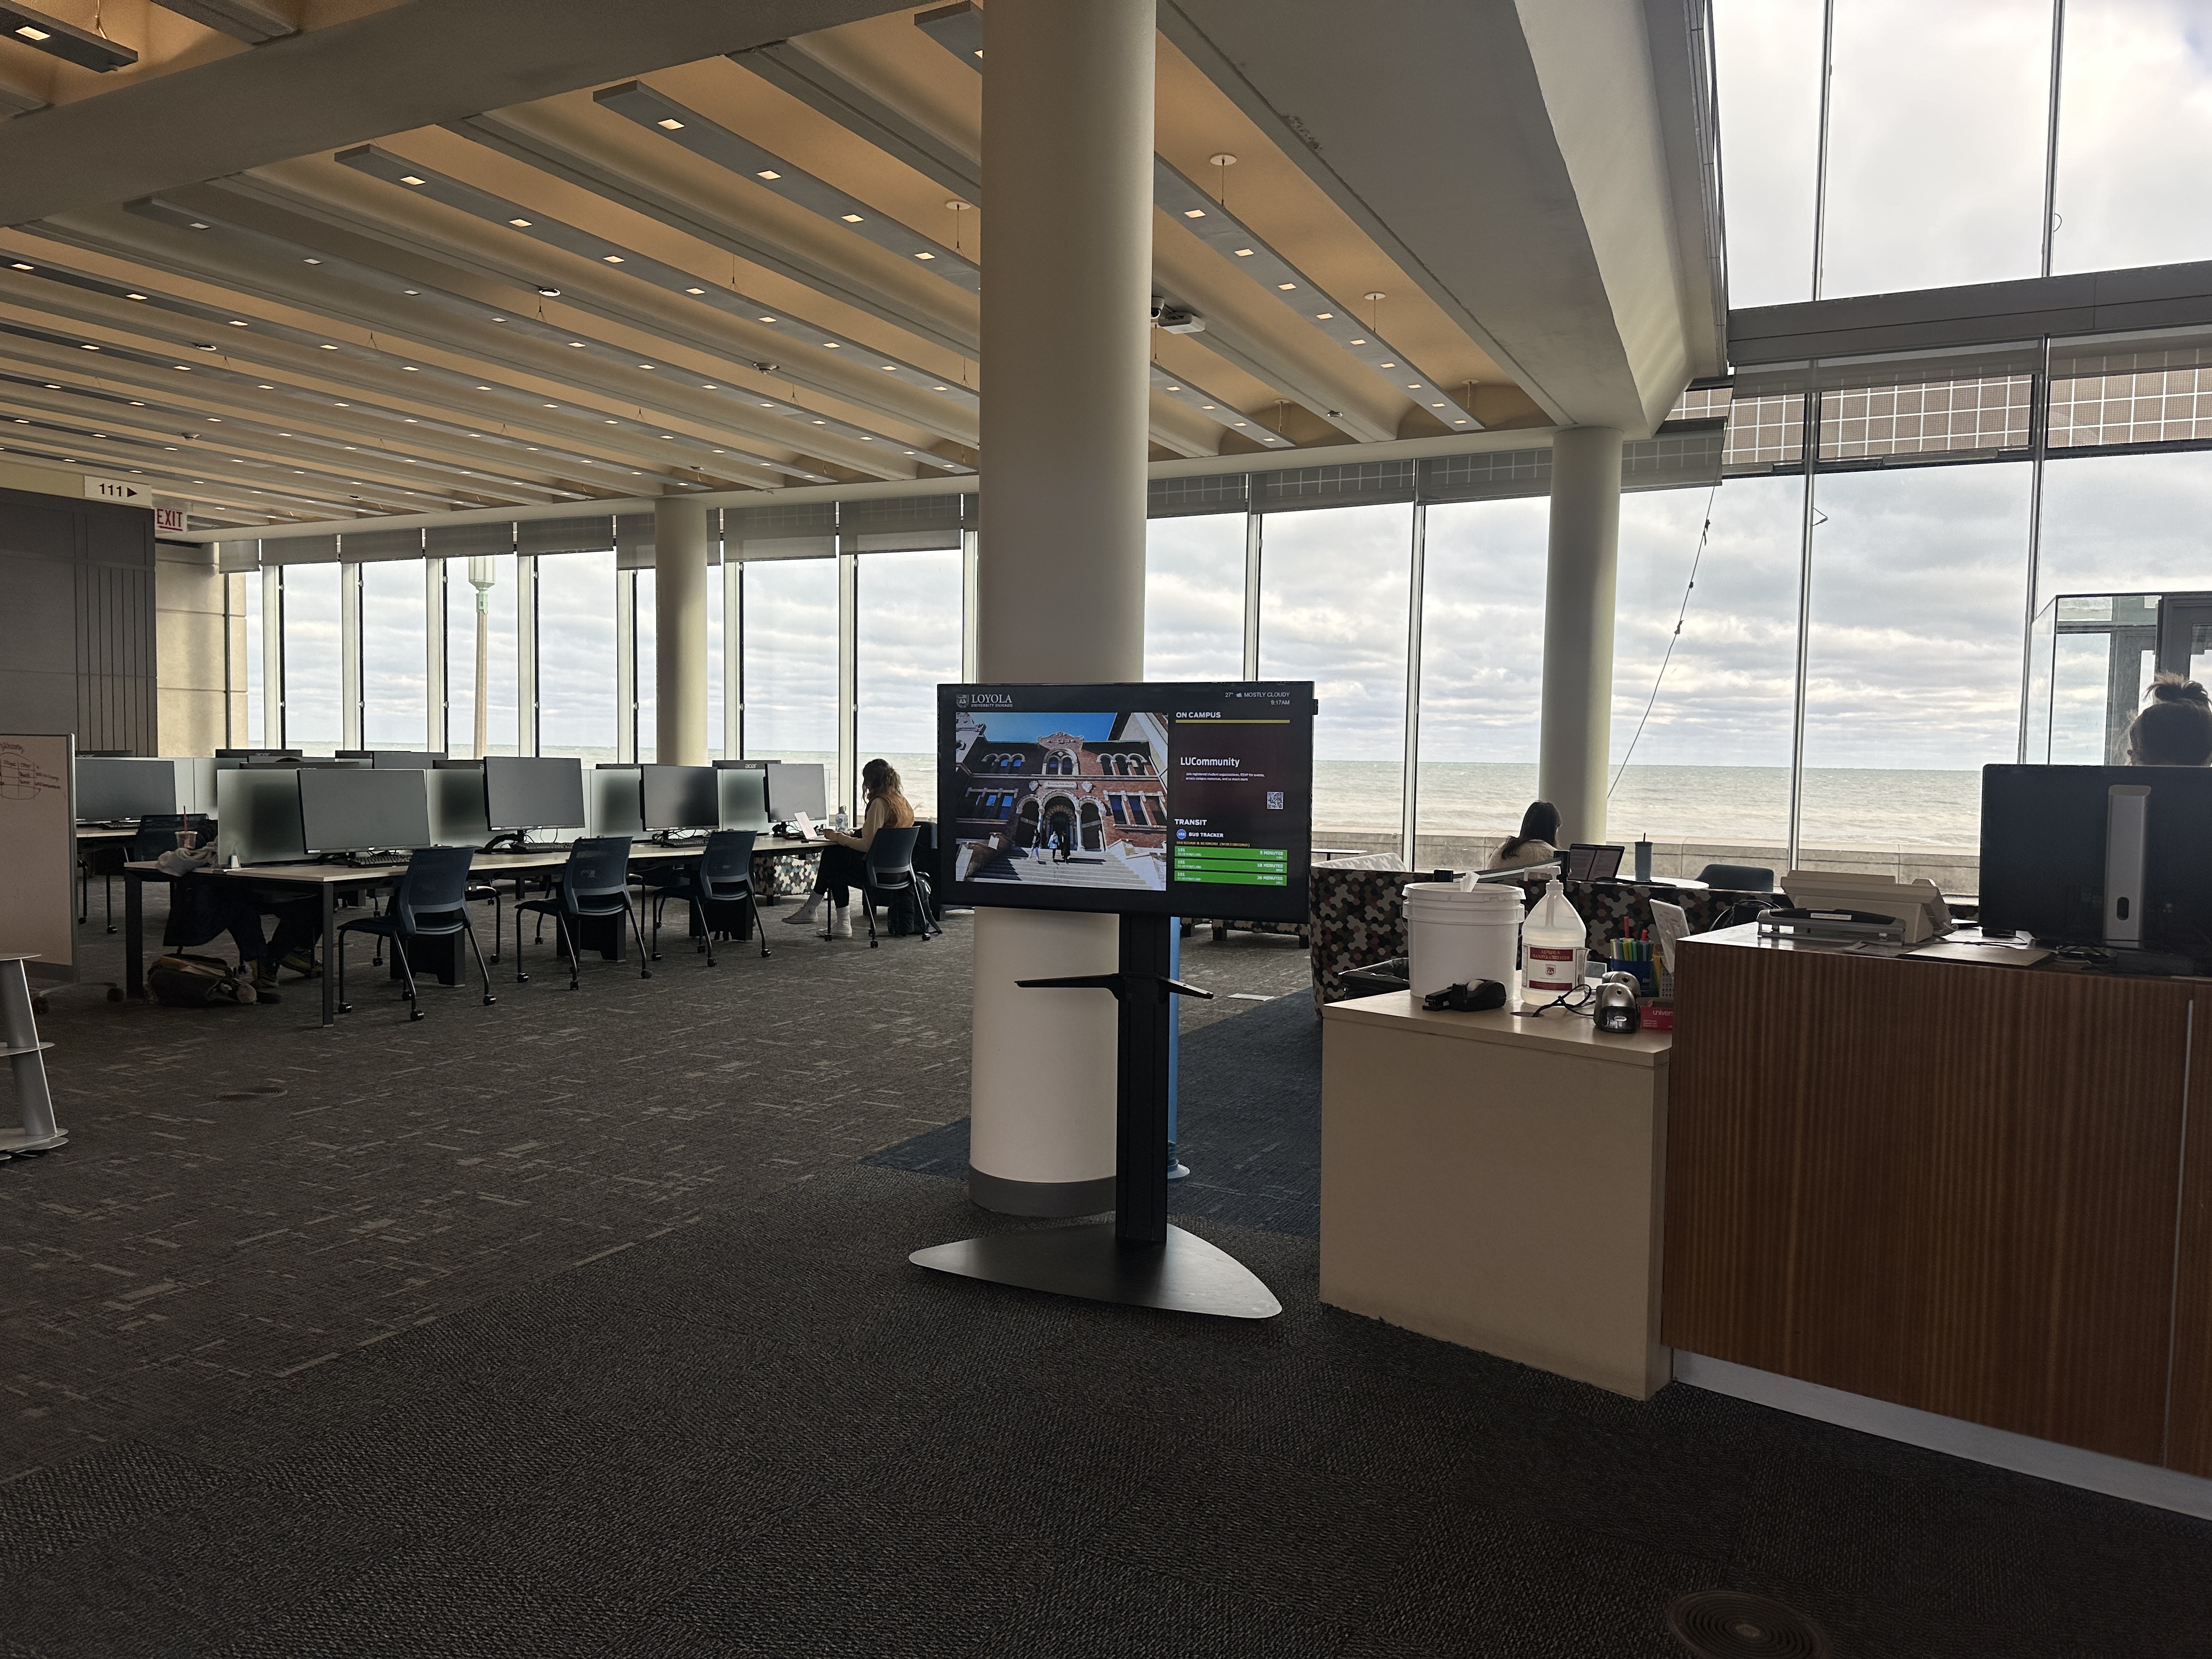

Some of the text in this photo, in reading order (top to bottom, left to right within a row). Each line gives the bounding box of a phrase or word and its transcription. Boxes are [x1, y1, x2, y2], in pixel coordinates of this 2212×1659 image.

[99, 483, 122, 496] 111
[157, 508, 183, 528] EXIT
[971, 694, 1013, 703] LOYOLA
[1180, 757, 1240, 768] LUCommunity
